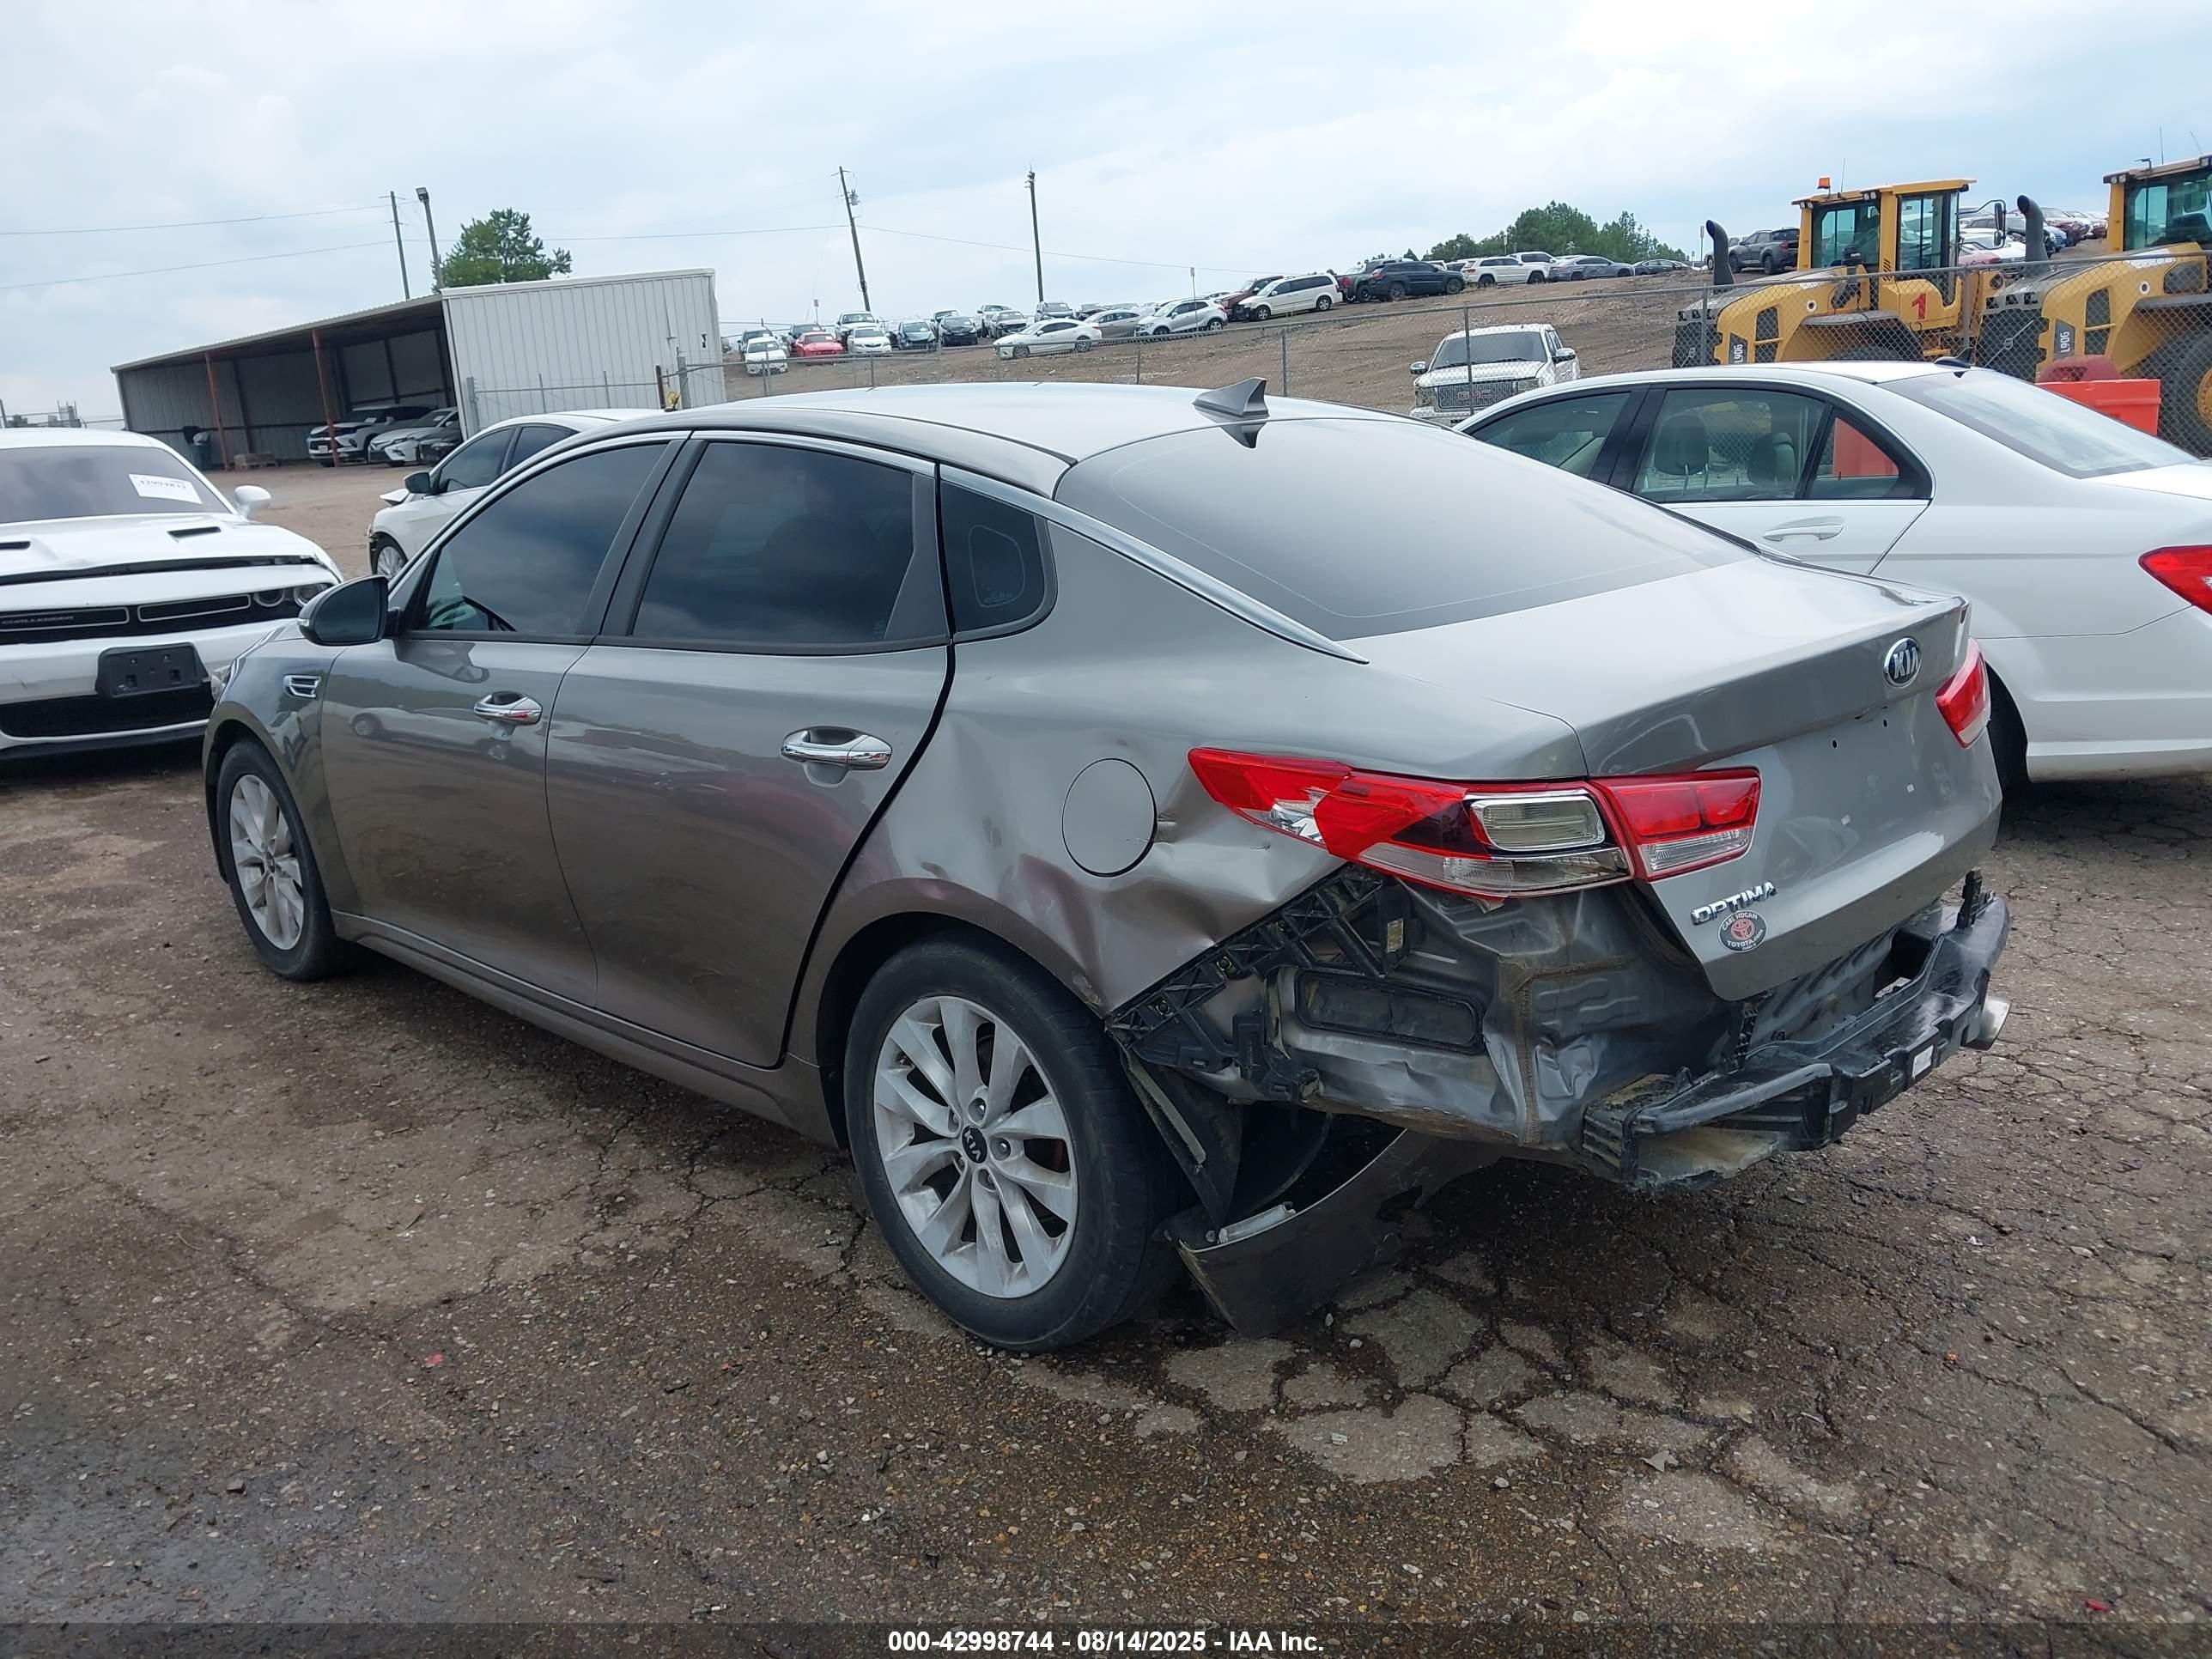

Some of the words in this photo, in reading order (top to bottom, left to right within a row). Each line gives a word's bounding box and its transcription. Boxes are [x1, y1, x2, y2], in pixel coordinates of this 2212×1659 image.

[1911, 293, 1927, 320] 1
[1733, 343, 1744, 363] L90G
[2060, 331, 2070, 353] L90G
[1893, 647, 1919, 679] KIA
[1691, 880, 1778, 926] OPTIMA
[1723, 915, 1735, 931] CARL
[1735, 912, 1758, 921] HOGAN
[964, 1129, 981, 1162] KIA
